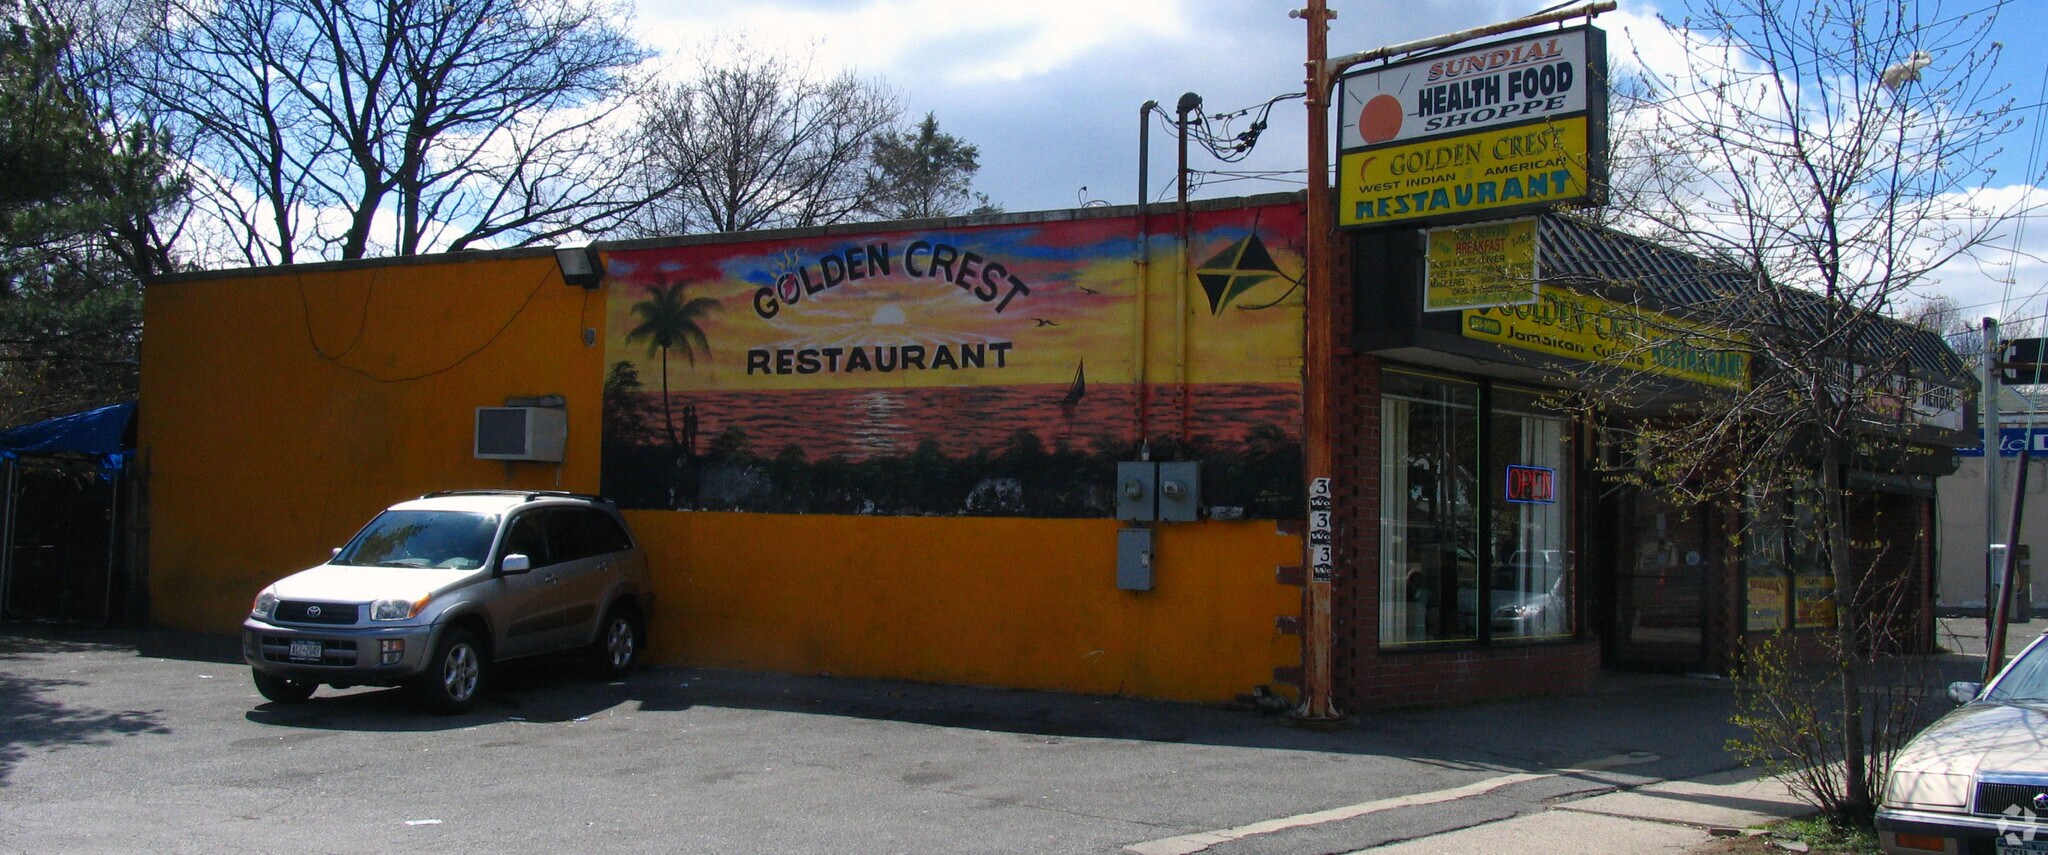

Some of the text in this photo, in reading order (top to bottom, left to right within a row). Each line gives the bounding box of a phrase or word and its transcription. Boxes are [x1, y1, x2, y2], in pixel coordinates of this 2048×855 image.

[1427, 38, 1564, 81] SUNDIAL
[1418, 61, 1573, 118] HEALTH FOOD
[1424, 95, 1566, 132] SHOPPE
[1389, 126, 1566, 176] GOLDEN CREST
[1359, 180, 1399, 194] WEST
[1406, 173, 1456, 188] INDIAN
[1484, 156, 1567, 176] AMERICAN
[1355, 169, 1571, 221] RESTAURANT
[1455, 238, 1506, 256] BREAKFAST
[752, 240, 1030, 319] GOLDEN CREST
[1507, 326, 1585, 352] Jamaican
[747, 342, 1013, 376] RESTAURANT
[1316, 479, 1328, 494] 3
[1509, 468, 1551, 500] OPEN
[1317, 513, 1328, 528] 3
[1320, 547, 1330, 562] 3
